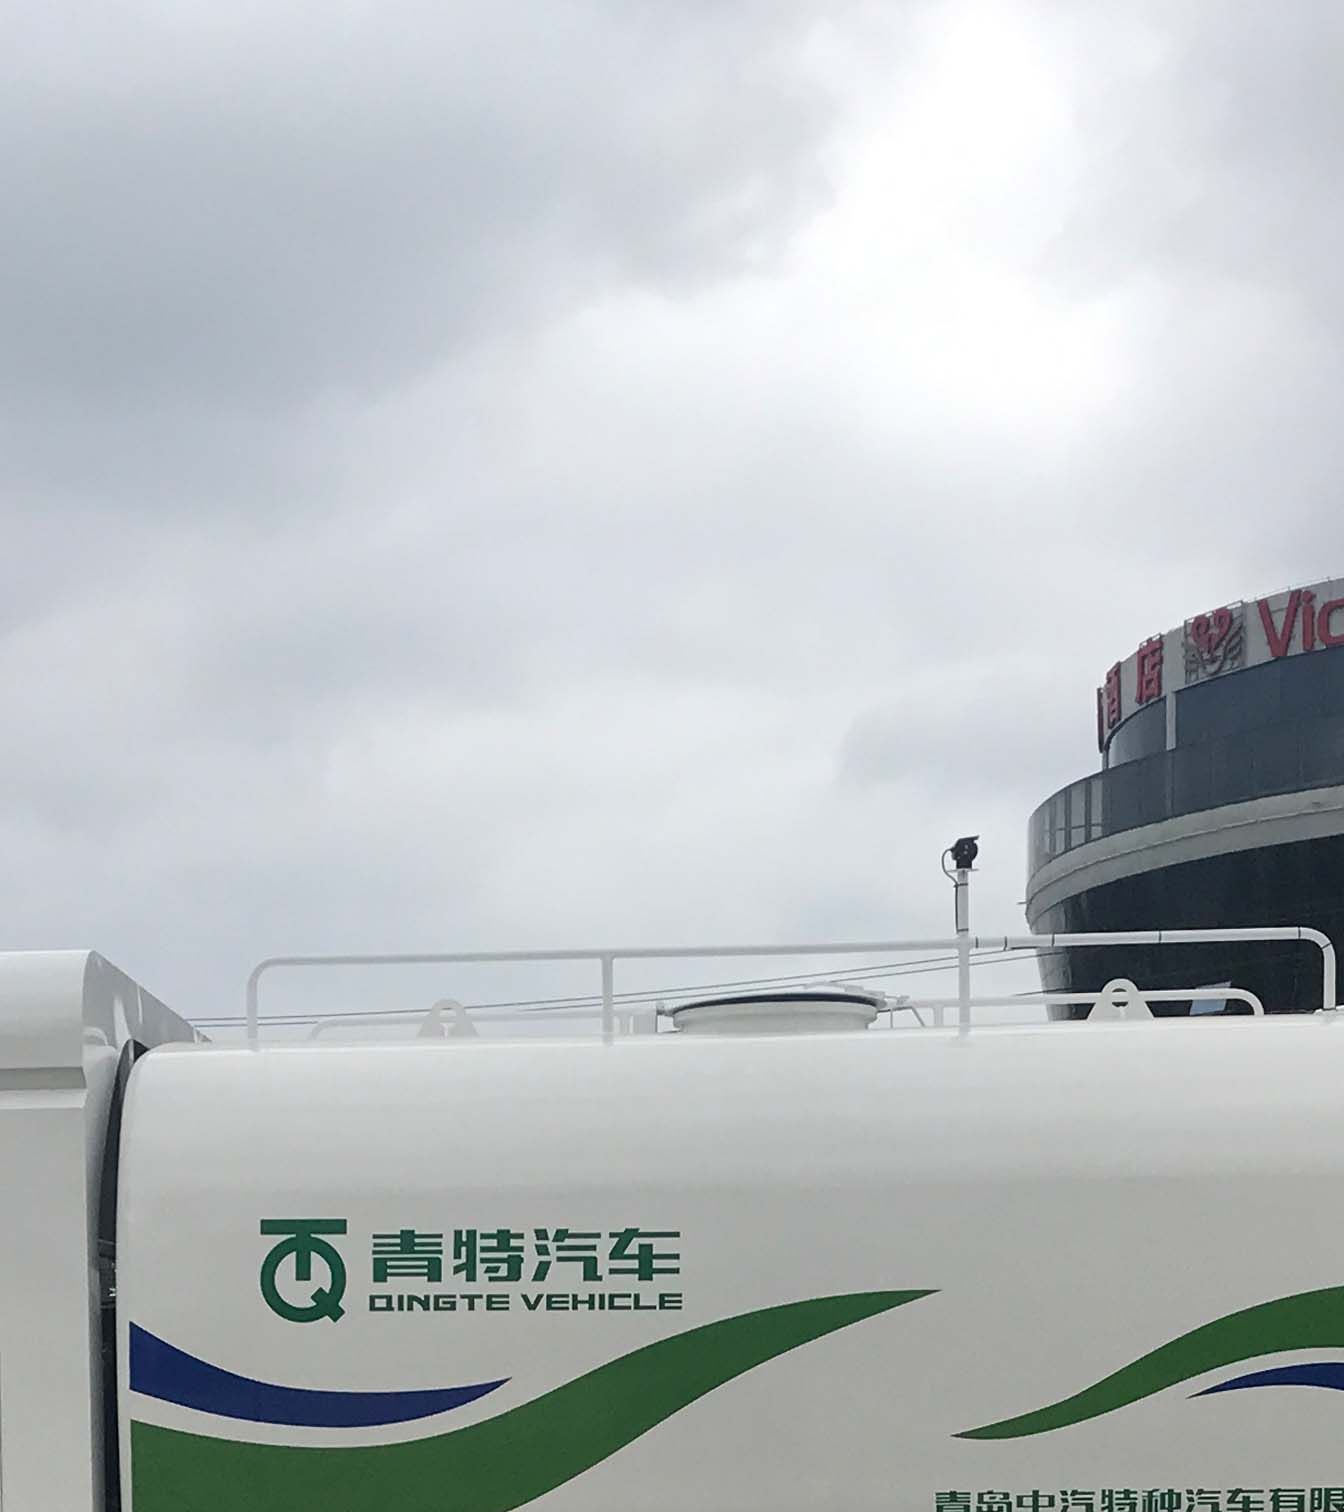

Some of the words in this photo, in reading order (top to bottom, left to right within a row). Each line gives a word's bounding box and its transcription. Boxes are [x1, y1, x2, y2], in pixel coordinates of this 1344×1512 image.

[371, 1228, 681, 1283] 青特汽车
[369, 1293, 511, 1312] QINGTE
[521, 1292, 683, 1311] VEHICLE
